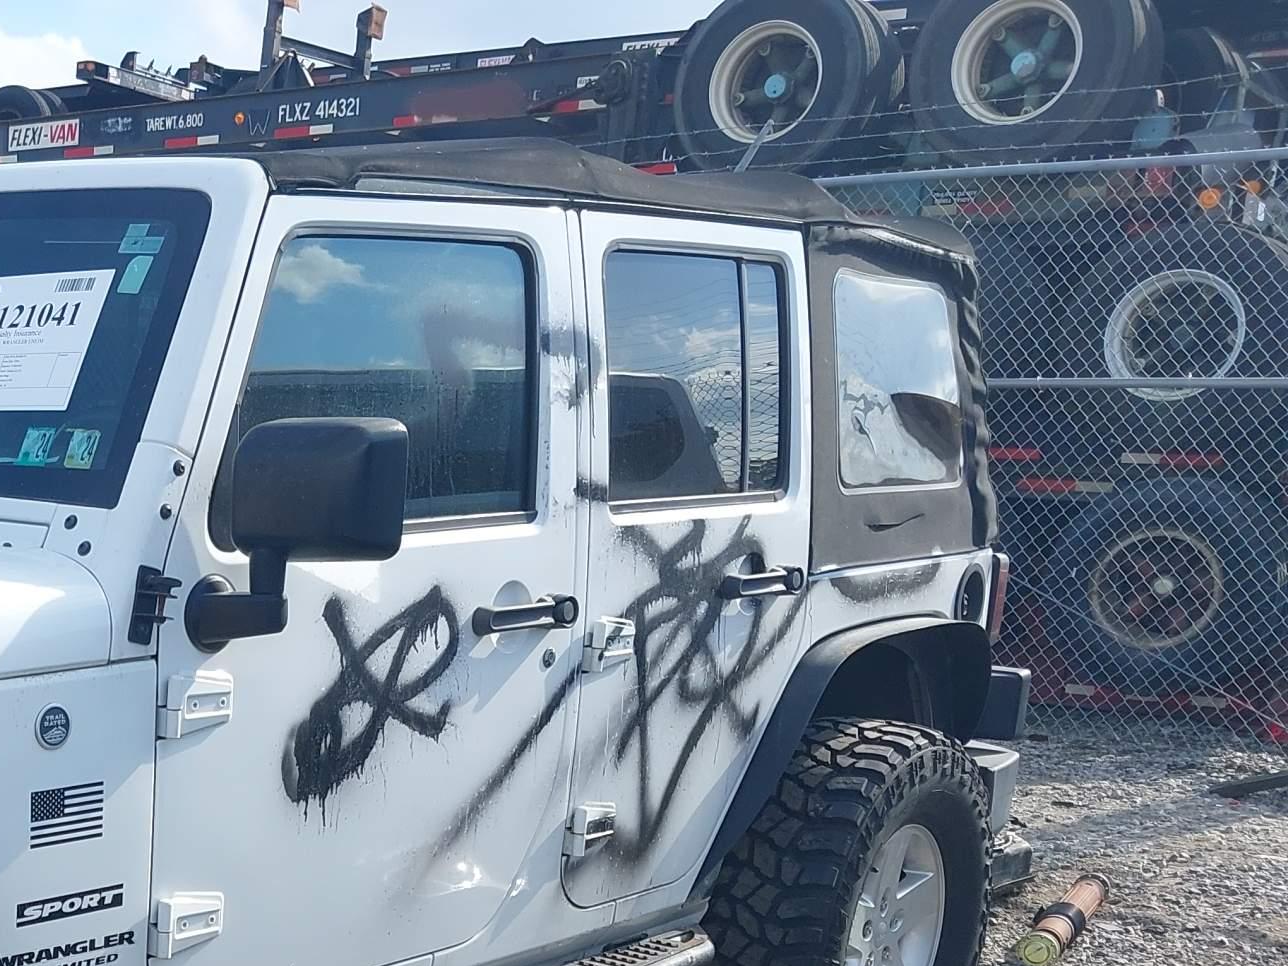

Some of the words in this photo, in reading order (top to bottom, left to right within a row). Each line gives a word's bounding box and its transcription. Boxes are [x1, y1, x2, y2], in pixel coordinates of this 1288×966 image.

[278, 102, 312, 124] FLXZ
[315, 97, 360, 119] 414321
[11, 122, 79, 147] FLEXI-VAN
[35, 433, 52, 459] 24
[80, 435, 98, 464] 24
[22, 889, 115, 921] SPORT
